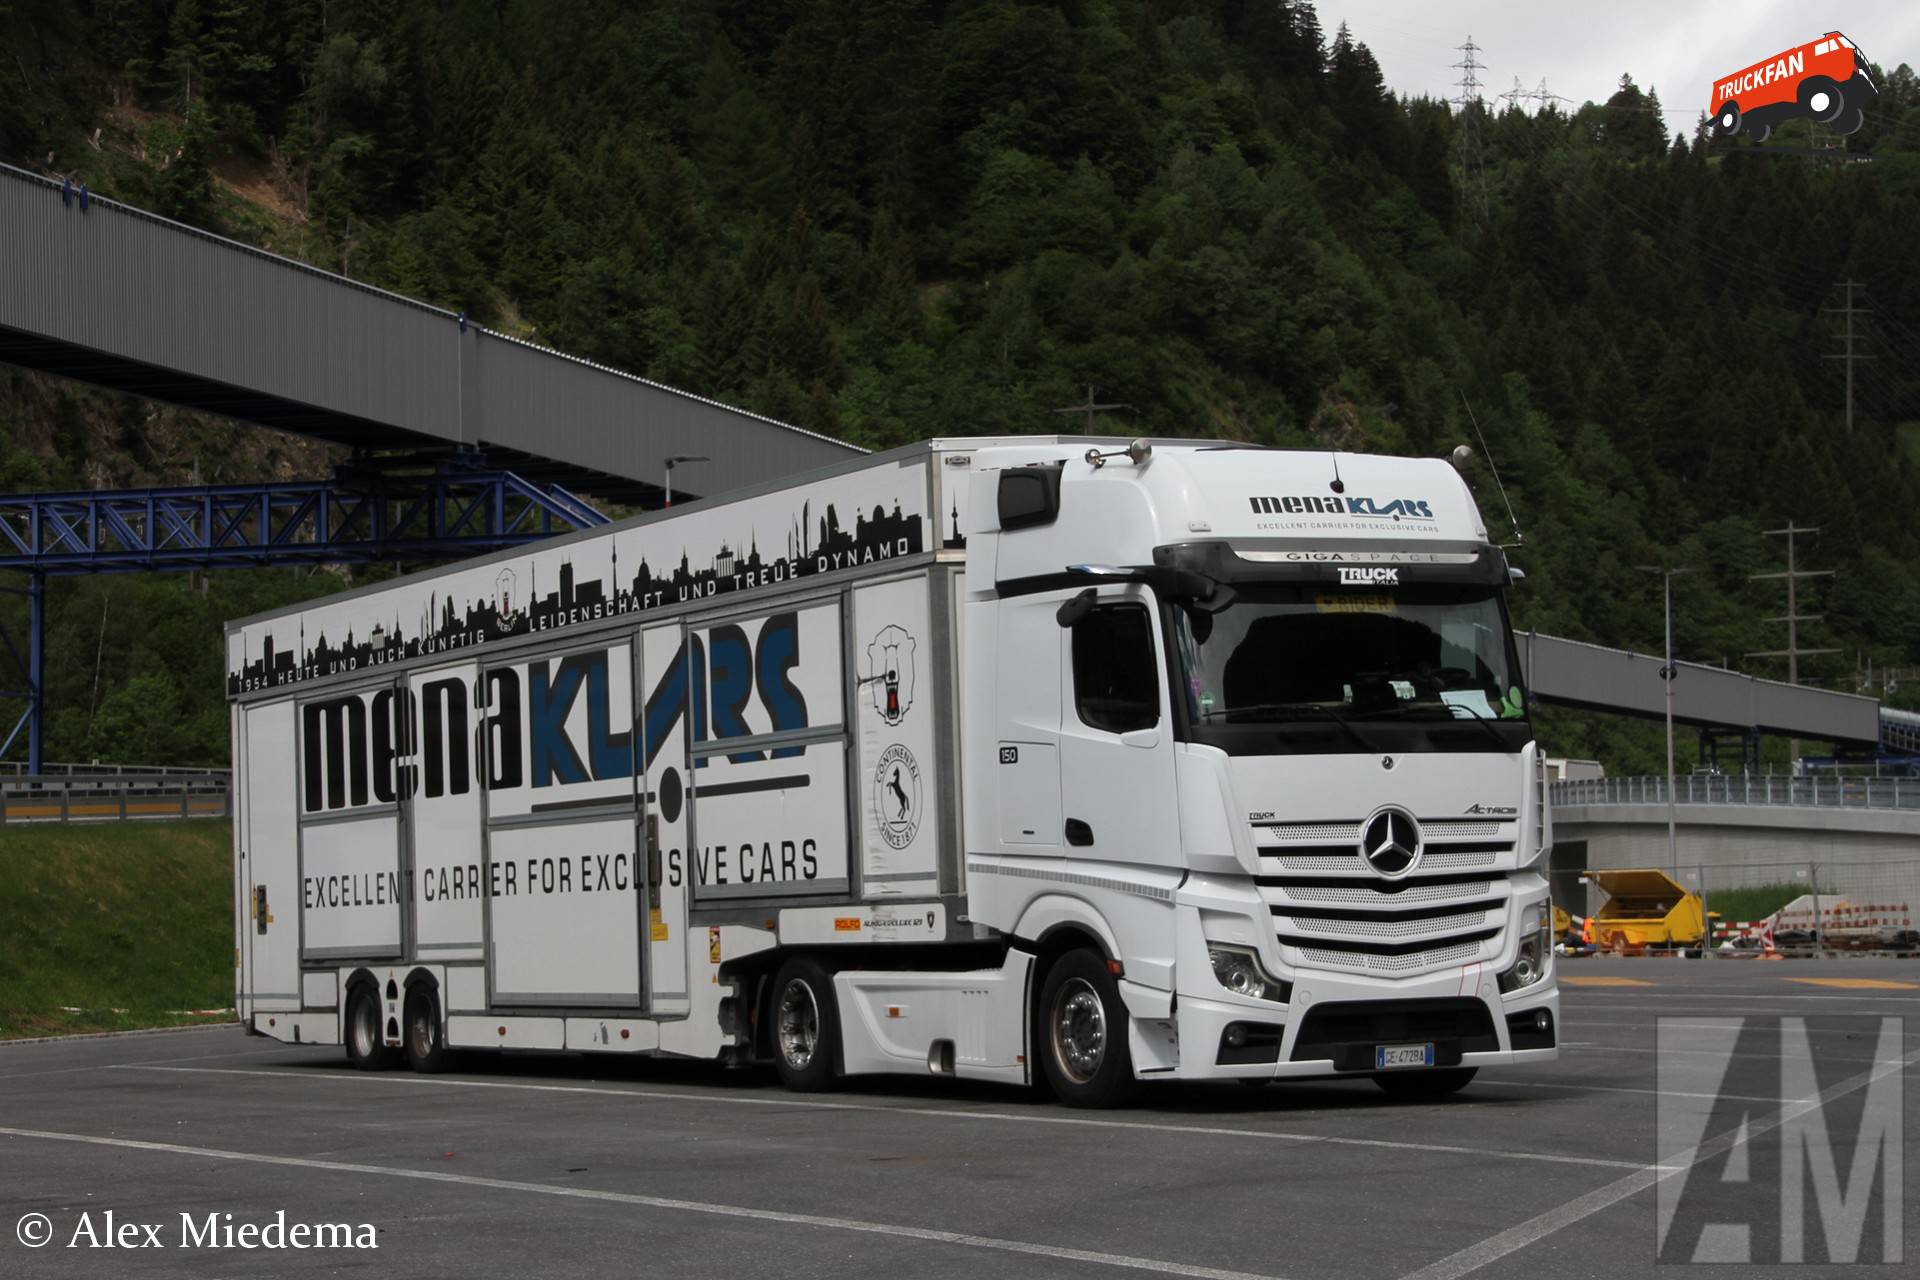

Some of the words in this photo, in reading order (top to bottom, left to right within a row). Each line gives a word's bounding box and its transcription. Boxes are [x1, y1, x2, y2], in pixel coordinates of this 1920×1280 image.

[1257, 522, 1307, 530] EXCELLENT
[1310, 522, 1348, 530] CARRIER
[1350, 522, 1367, 530] FOR
[1369, 523, 1415, 532] EXCLUSIVE
[1418, 525, 1439, 533] CARS
[1337, 567, 1399, 585] TRUCK
[239, 675, 268, 692] 1954
[278, 664, 320, 683] HEUTE
[330, 658, 357, 674] UND
[368, 646, 405, 666] AUCH
[418, 629, 485, 656] KÜNFTIG
[529, 591, 663, 632] LEIDENSCHAFT
[679, 580, 716, 602] UND
[733, 562, 798, 591] TREUE
[818, 537, 908, 573] DYNAMO
[876, 747, 919, 784] CONTINENTAL
[1001, 749, 1016, 762] 150
[424, 861, 517, 902] CARRIER
[528, 856, 572, 894] FOR
[581, 845, 728, 892] EXCLUSIVE
[740, 838, 818, 883] CARS
